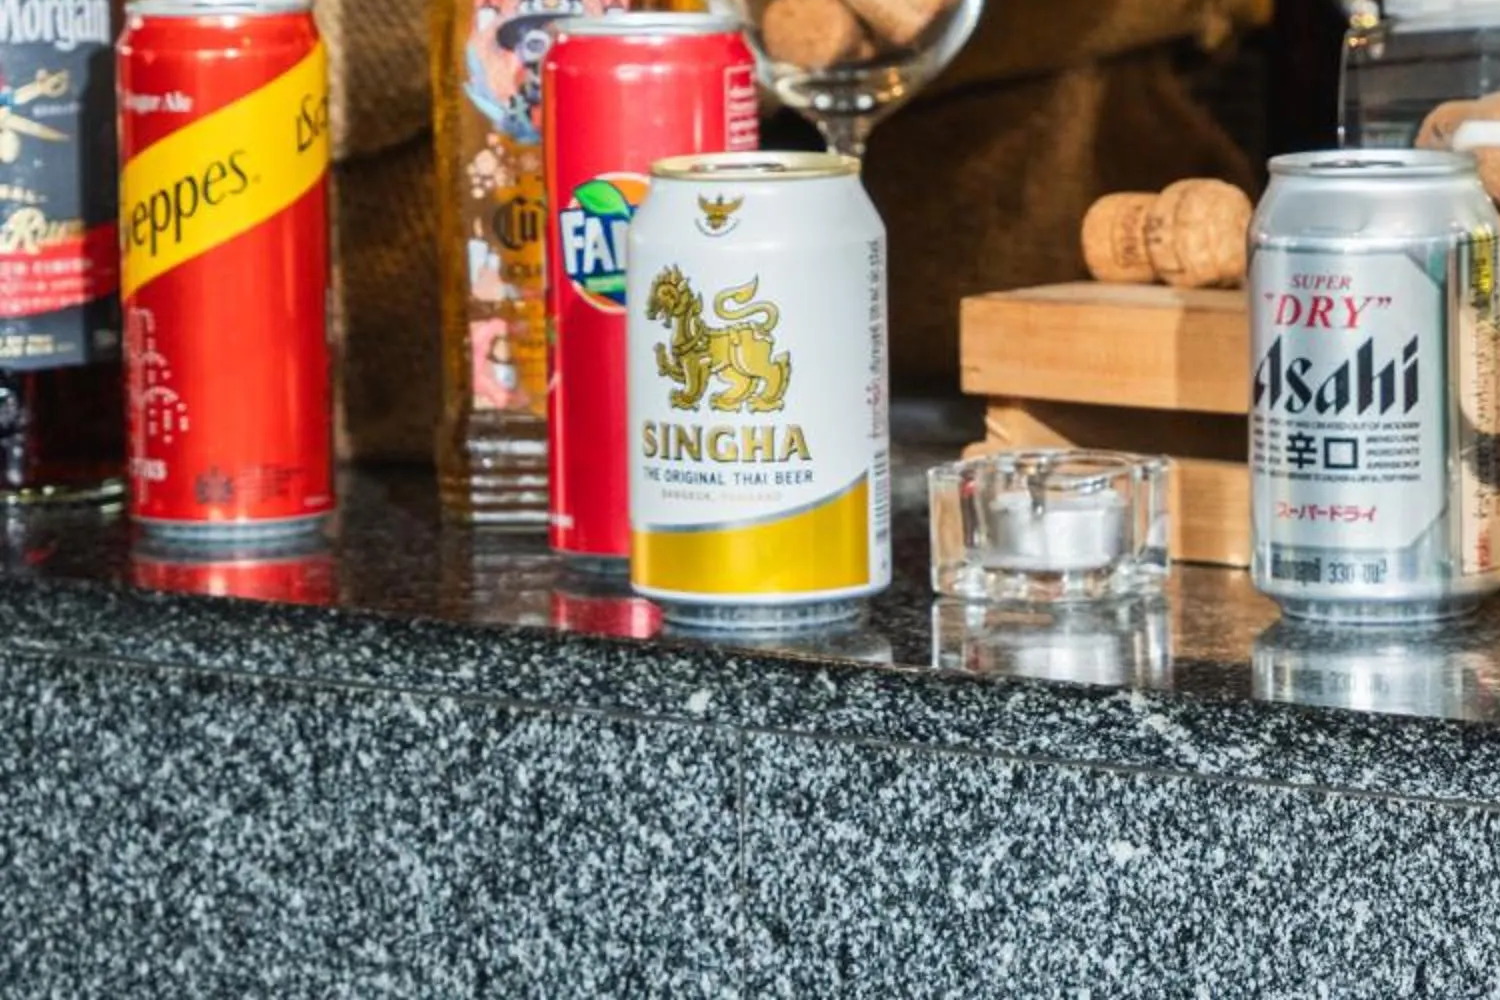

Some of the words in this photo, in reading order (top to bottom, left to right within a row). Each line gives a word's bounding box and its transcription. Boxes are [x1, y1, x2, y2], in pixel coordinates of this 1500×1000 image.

[125, 149, 249, 258] eppes
[1290, 272, 1353, 291] SUPER
[1253, 334, 1419, 417] Asahi
[642, 420, 813, 463] SINGHA
[1285, 431, 1359, 470] 辛口
[644, 466, 660, 482] THE
[663, 469, 724, 485] ORIGINAL
[733, 471, 768, 486] THAI
[775, 469, 814, 485] BEER
[1327, 561, 1356, 585] 330
